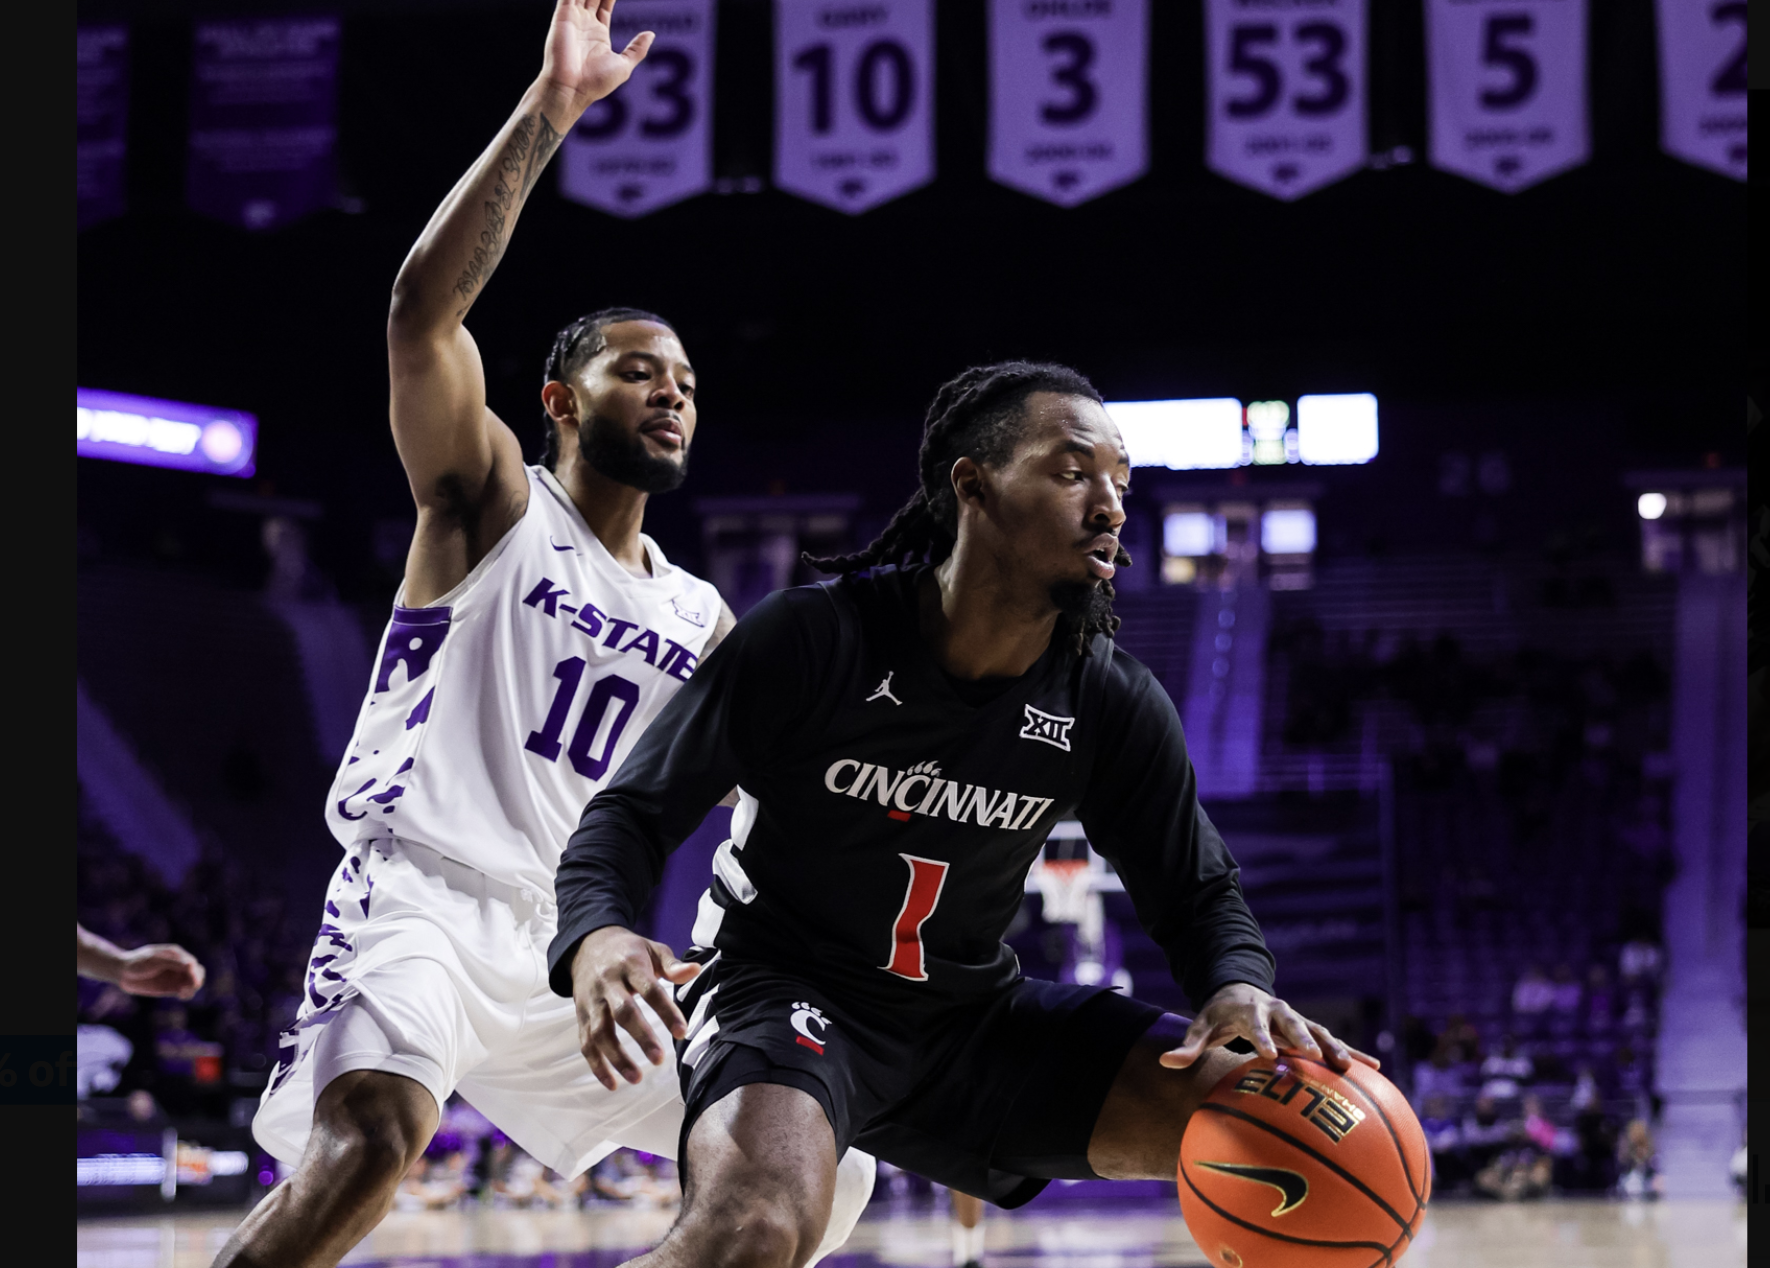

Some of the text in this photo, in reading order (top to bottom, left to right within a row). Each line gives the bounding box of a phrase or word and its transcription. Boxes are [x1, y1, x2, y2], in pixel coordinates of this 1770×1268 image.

[793, 39, 915, 134] 10
[1040, 31, 1099, 126] 3
[1226, 23, 1349, 118] 53
[1480, 14, 1540, 110] 5
[523, 577, 698, 683] K-STATE
[524, 655, 640, 782] 10
[1021, 706, 1074, 750] XII
[824, 757, 1055, 831] CINCINNATI
[877, 853, 950, 982] 1
[1233, 1068, 1360, 1145] ELITE
